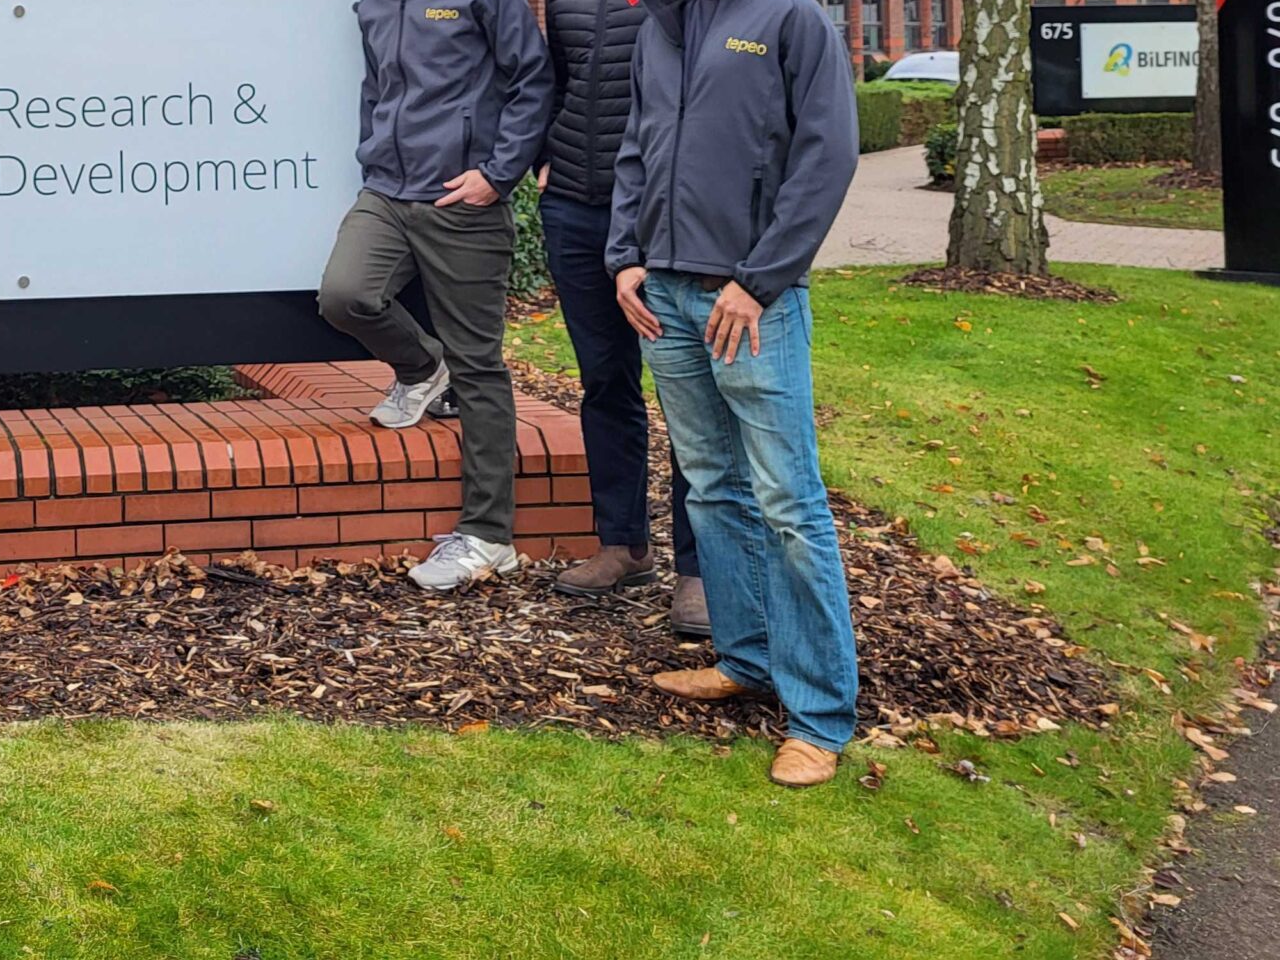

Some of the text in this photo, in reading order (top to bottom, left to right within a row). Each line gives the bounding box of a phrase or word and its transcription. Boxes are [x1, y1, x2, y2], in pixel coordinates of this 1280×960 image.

[425, 7, 460, 21] tepeo
[1040, 22, 1073, 40] 675
[725, 36, 767, 56] tepeo
[233, 82, 269, 125] &
